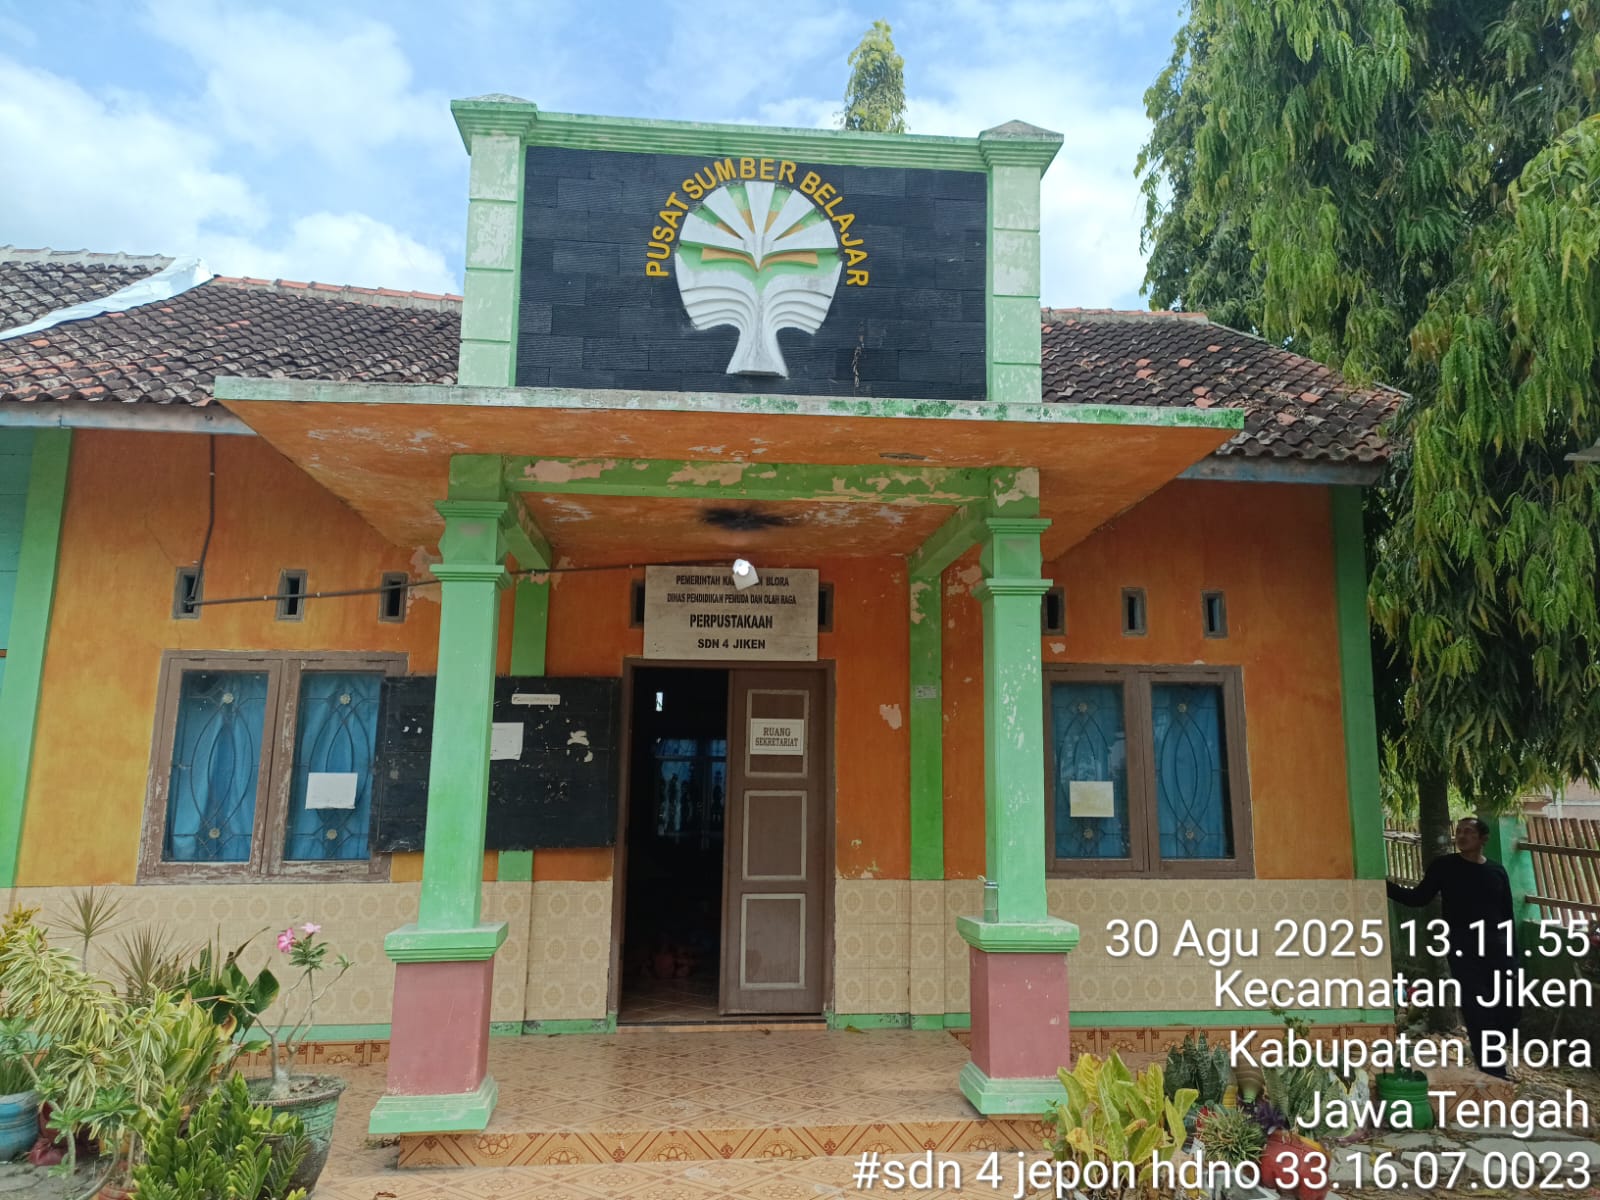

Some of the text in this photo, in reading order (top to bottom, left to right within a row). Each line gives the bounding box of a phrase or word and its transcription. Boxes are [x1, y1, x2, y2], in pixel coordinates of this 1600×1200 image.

[645, 157, 870, 287] PUSAT SUMBER BELAJAR
[676, 575, 720, 585] PEMERINTAH
[766, 576, 789, 586] BLORA
[667, 593, 685, 603] DINAS
[686, 593, 724, 604] PENDIDIKAN
[724, 593, 749, 605] PEMUDA
[750, 594, 763, 605] DAN
[689, 613, 773, 629] PERPUSTAKAAN
[697, 638, 766, 650] SDN 4 JIKEN
[763, 727, 791, 737] RUANG
[755, 737, 798, 746] SEKRETARIAT
